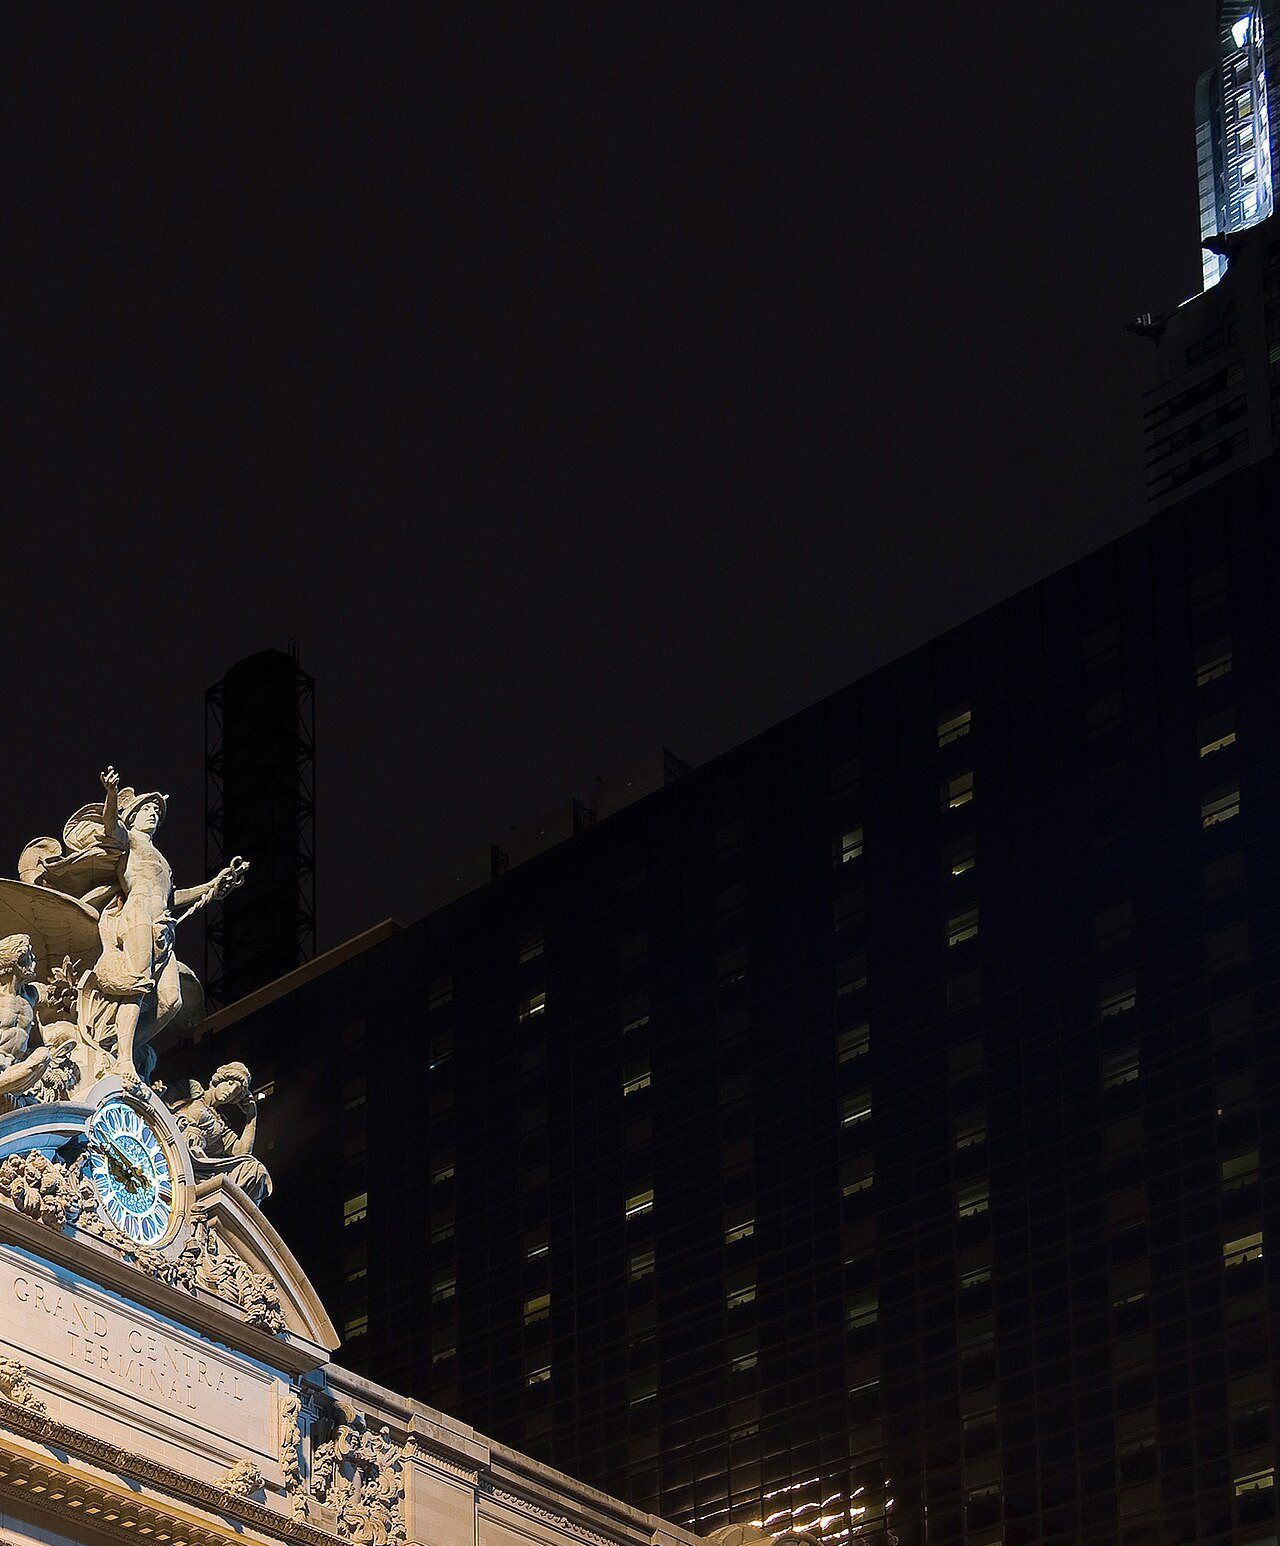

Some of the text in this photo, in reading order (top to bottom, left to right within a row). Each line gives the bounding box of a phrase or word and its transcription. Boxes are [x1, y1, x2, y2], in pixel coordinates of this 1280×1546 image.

[13, 1278, 244, 1401] GRAND CENTRAL
[67, 1331, 197, 1410] TERMINAL
